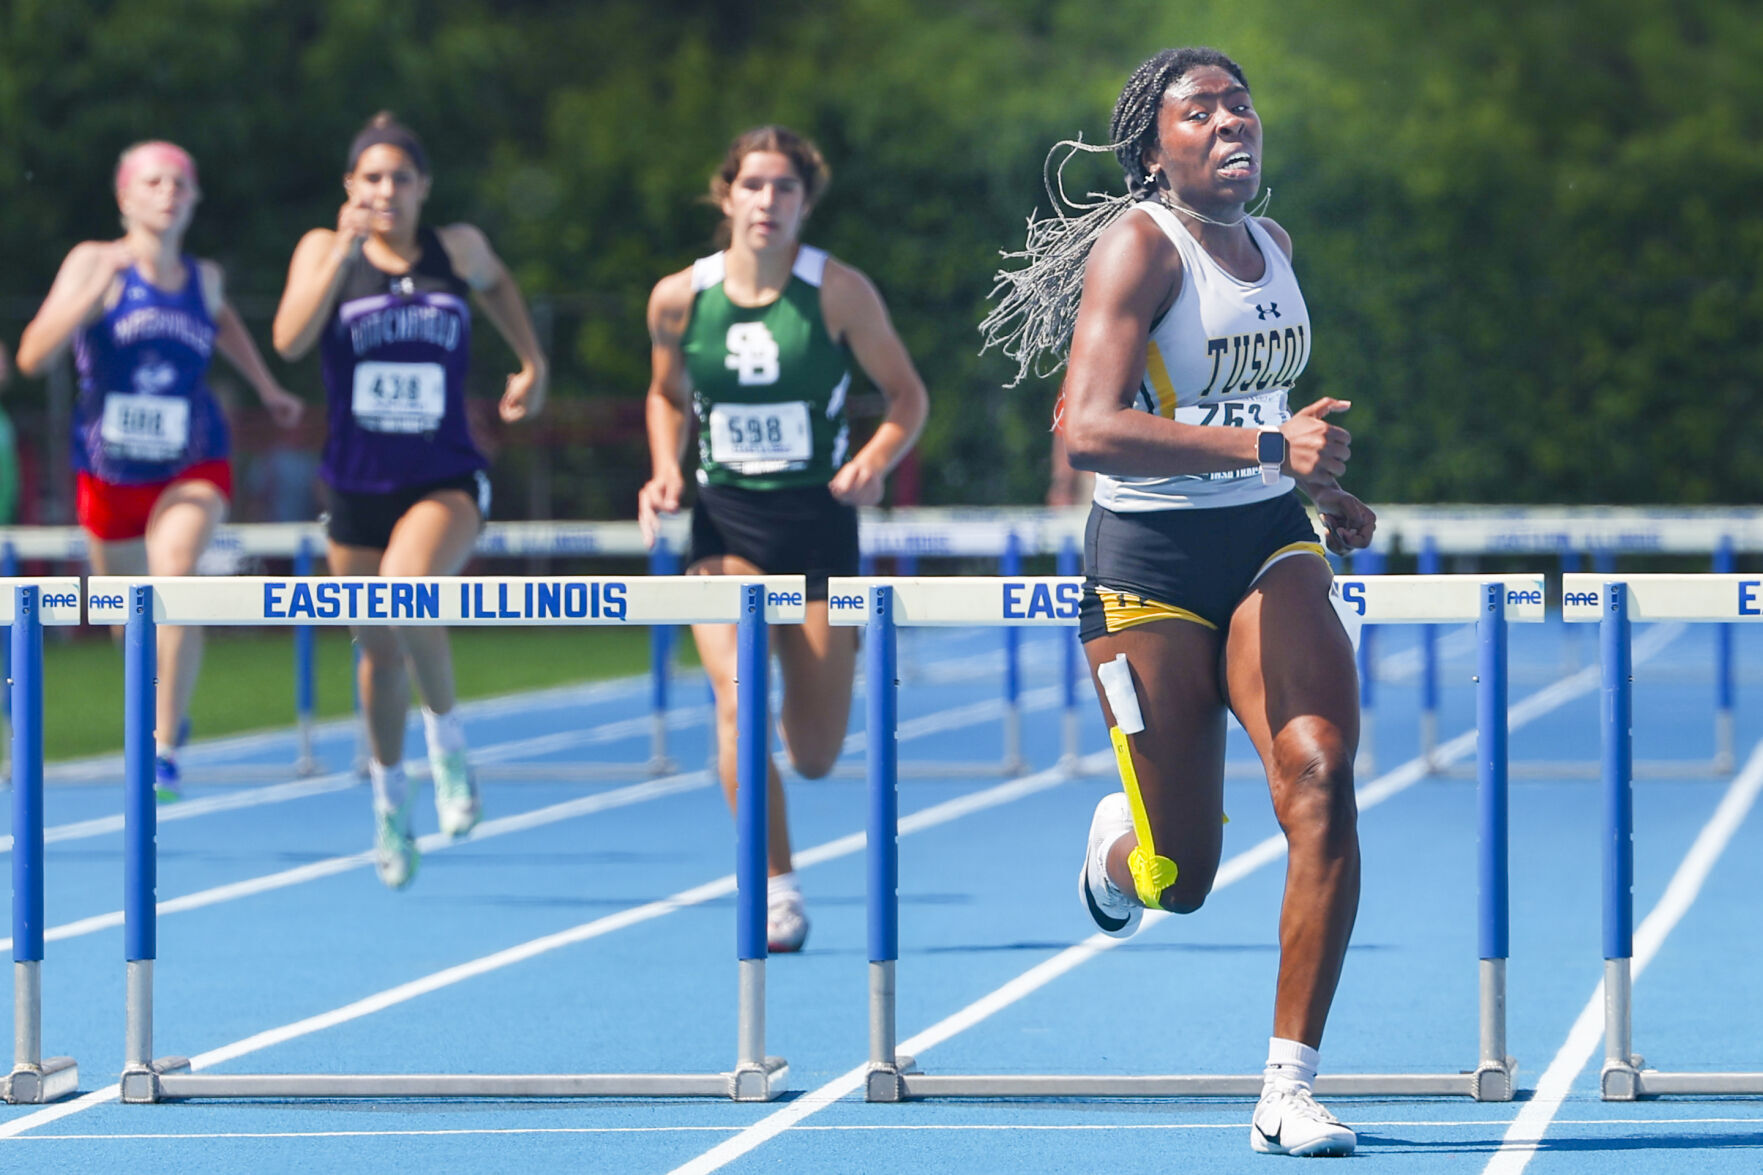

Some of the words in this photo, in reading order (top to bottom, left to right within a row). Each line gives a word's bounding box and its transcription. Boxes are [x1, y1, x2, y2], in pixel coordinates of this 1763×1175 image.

[728, 415, 782, 443] 598
[263, 582, 440, 619] EASTERN
[460, 582, 629, 621] ILLINOIS
